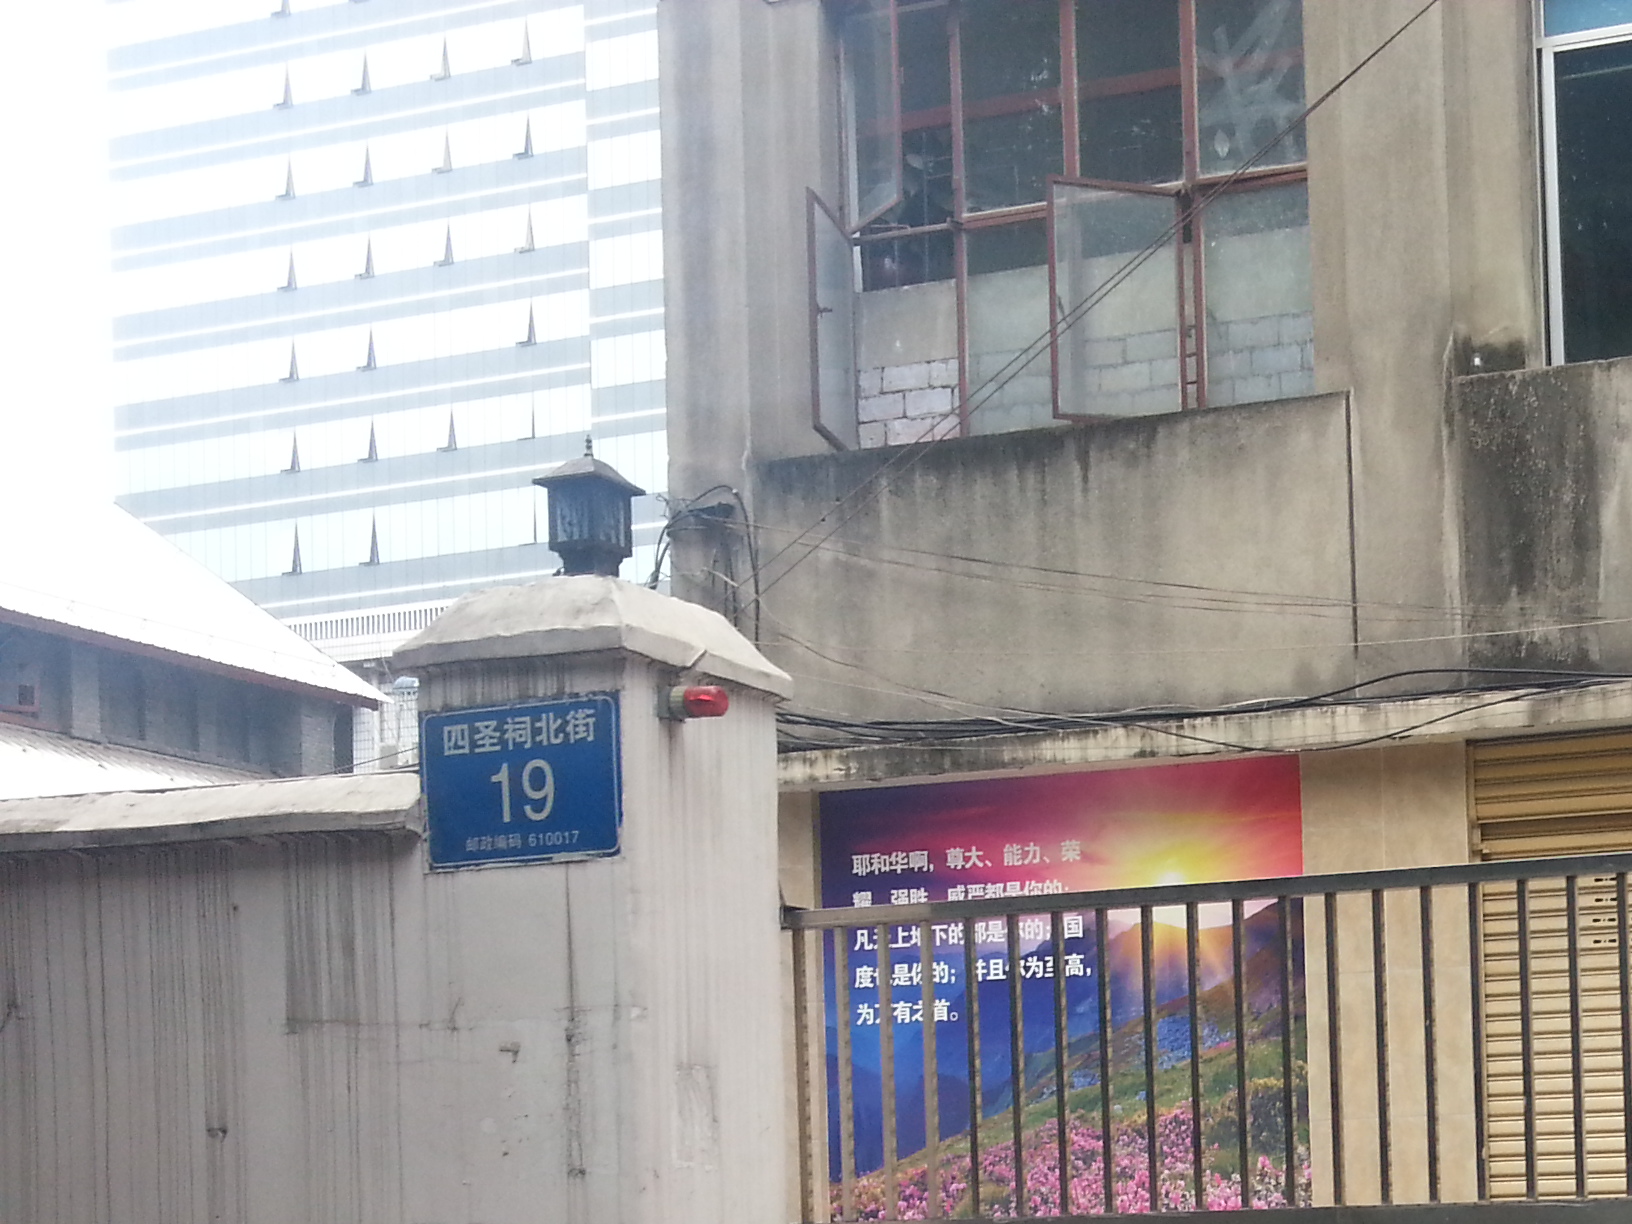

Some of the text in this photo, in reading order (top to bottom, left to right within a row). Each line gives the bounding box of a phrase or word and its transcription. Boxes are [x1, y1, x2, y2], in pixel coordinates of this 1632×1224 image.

[443, 708, 596, 756] 四圣祠北街
[490, 758, 555, 823] 19
[528, 830, 580, 847] 610017
